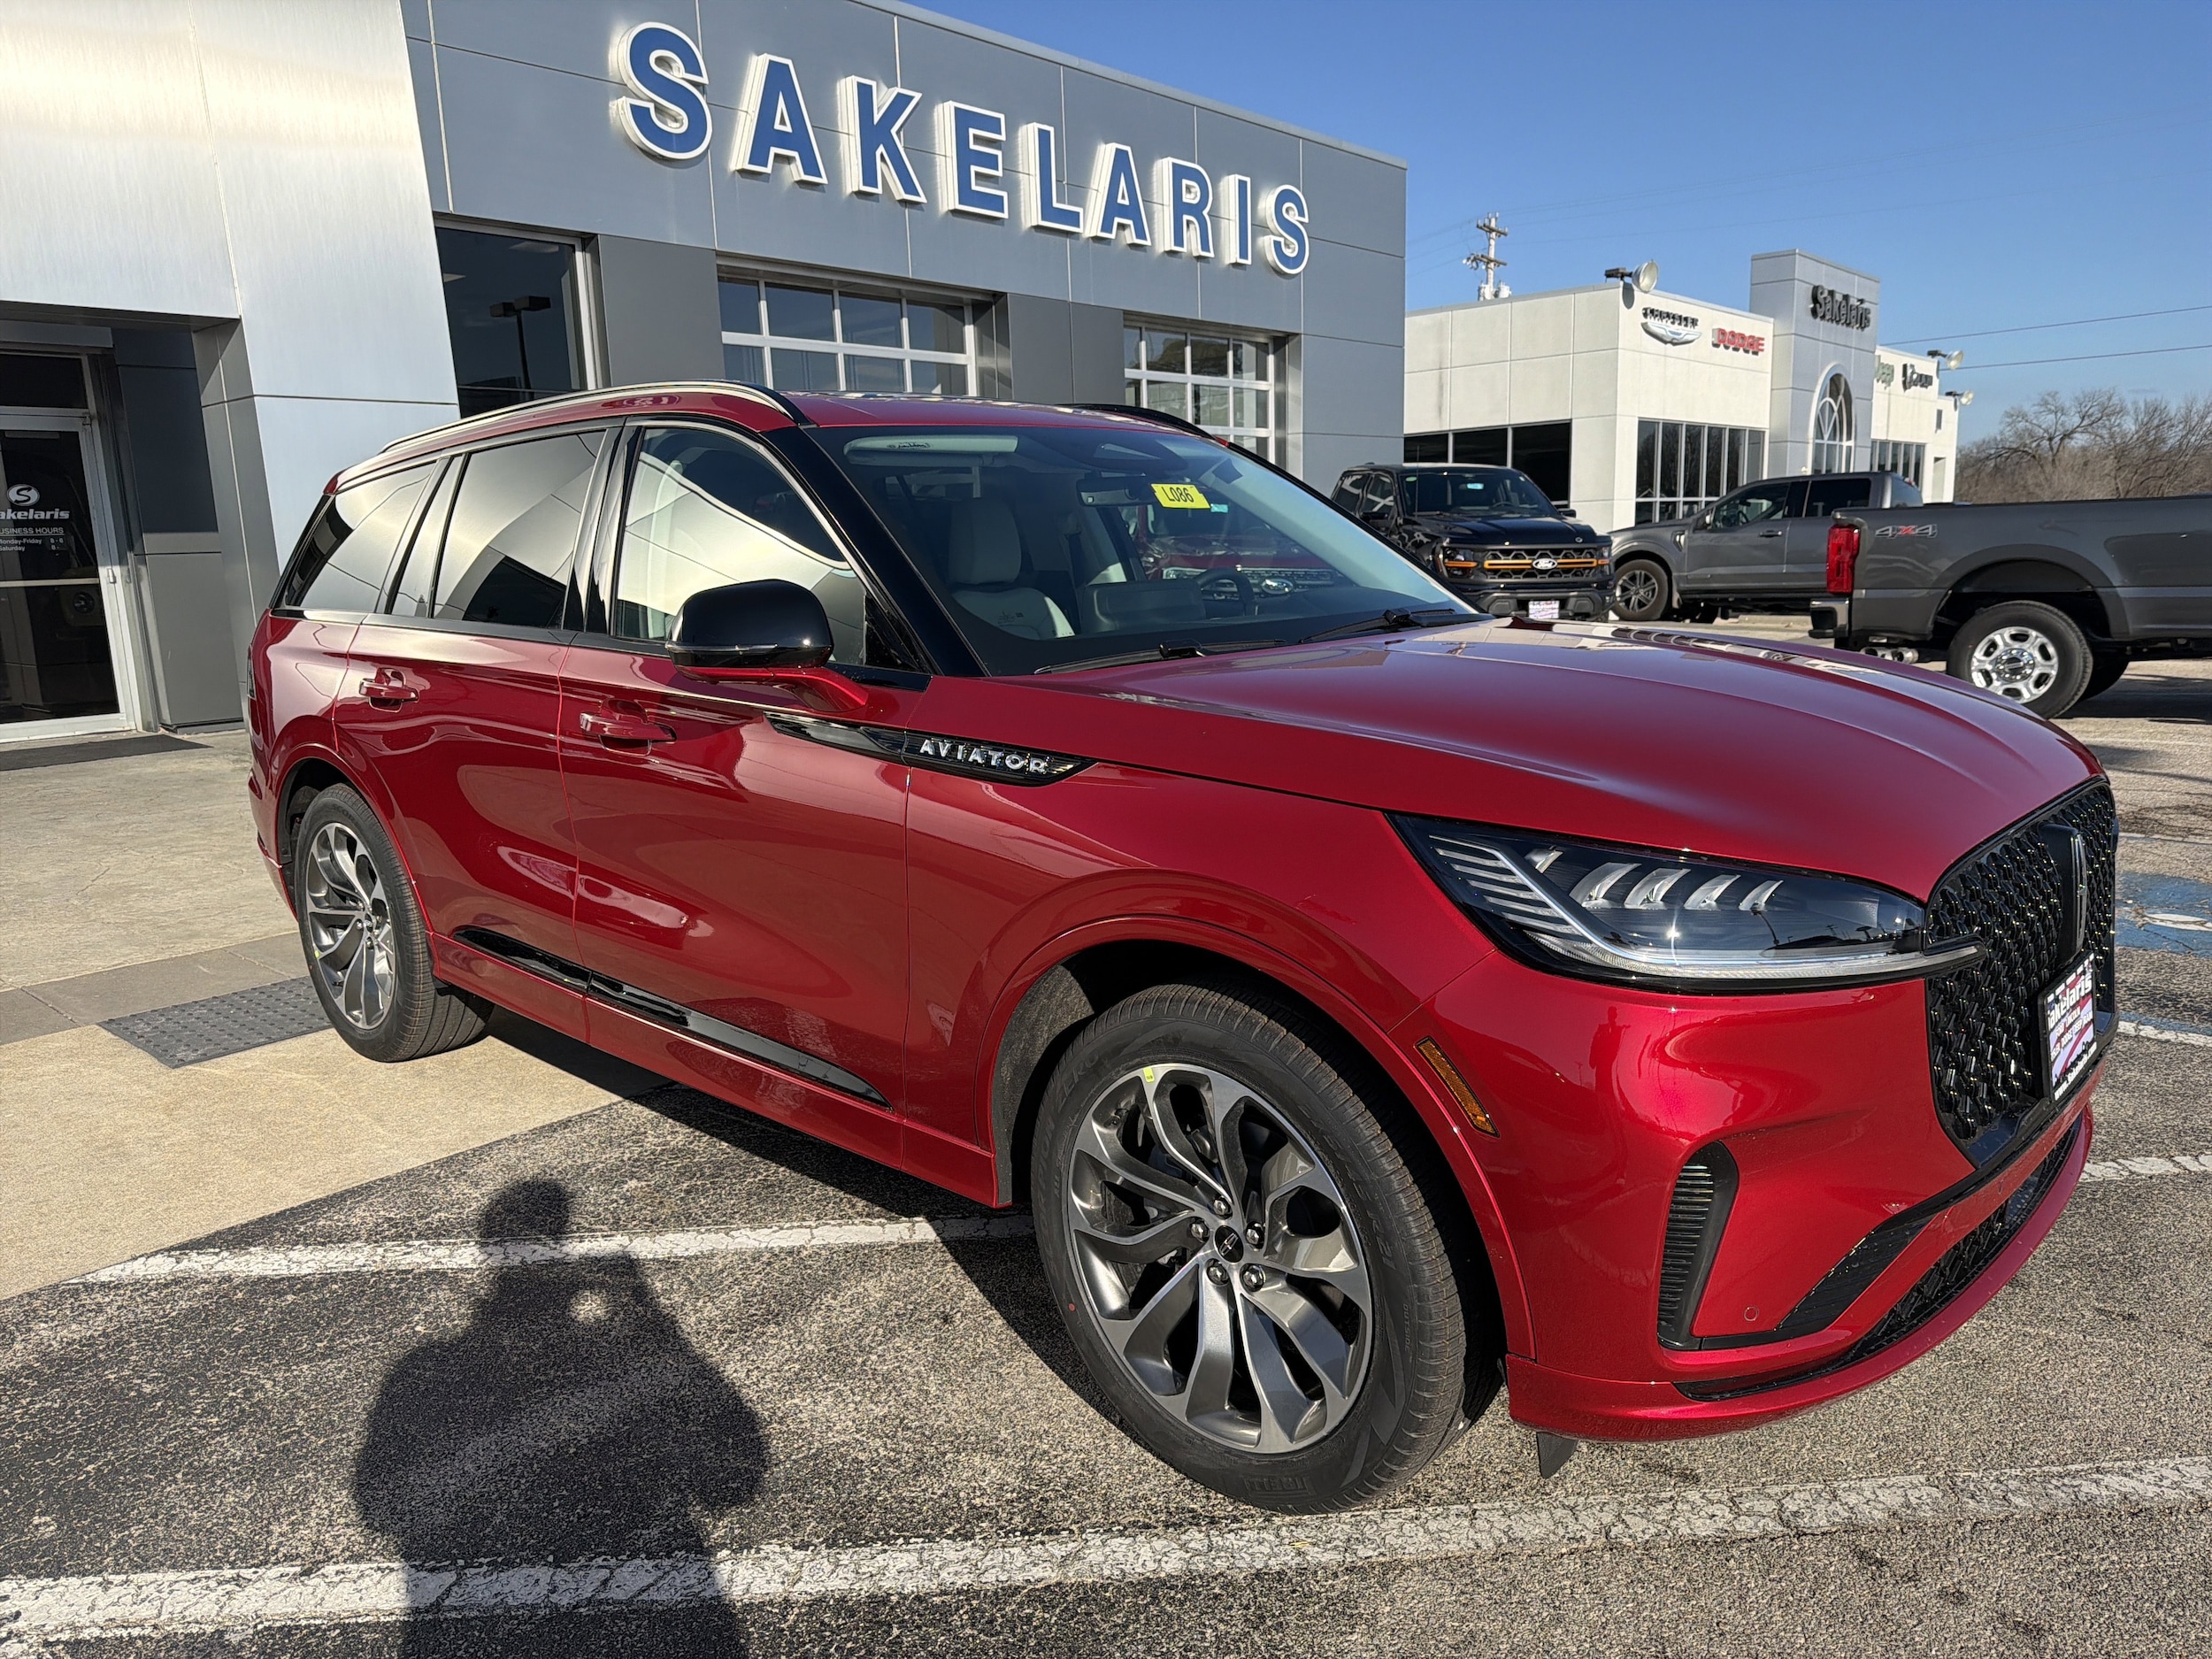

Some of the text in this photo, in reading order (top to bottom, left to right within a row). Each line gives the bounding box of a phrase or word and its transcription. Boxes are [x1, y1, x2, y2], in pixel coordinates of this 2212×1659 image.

[616, 20, 1310, 276] SAKELARIS
[1811, 284, 1871, 332] Sakelaris
[1713, 327, 1765, 355] DODGE
[1165, 485, 1195, 504] L086
[0, 508, 70, 520] akelaris
[919, 739, 1047, 774] AVIATOR
[1401, 1302, 1411, 1354] OUTSIDE
